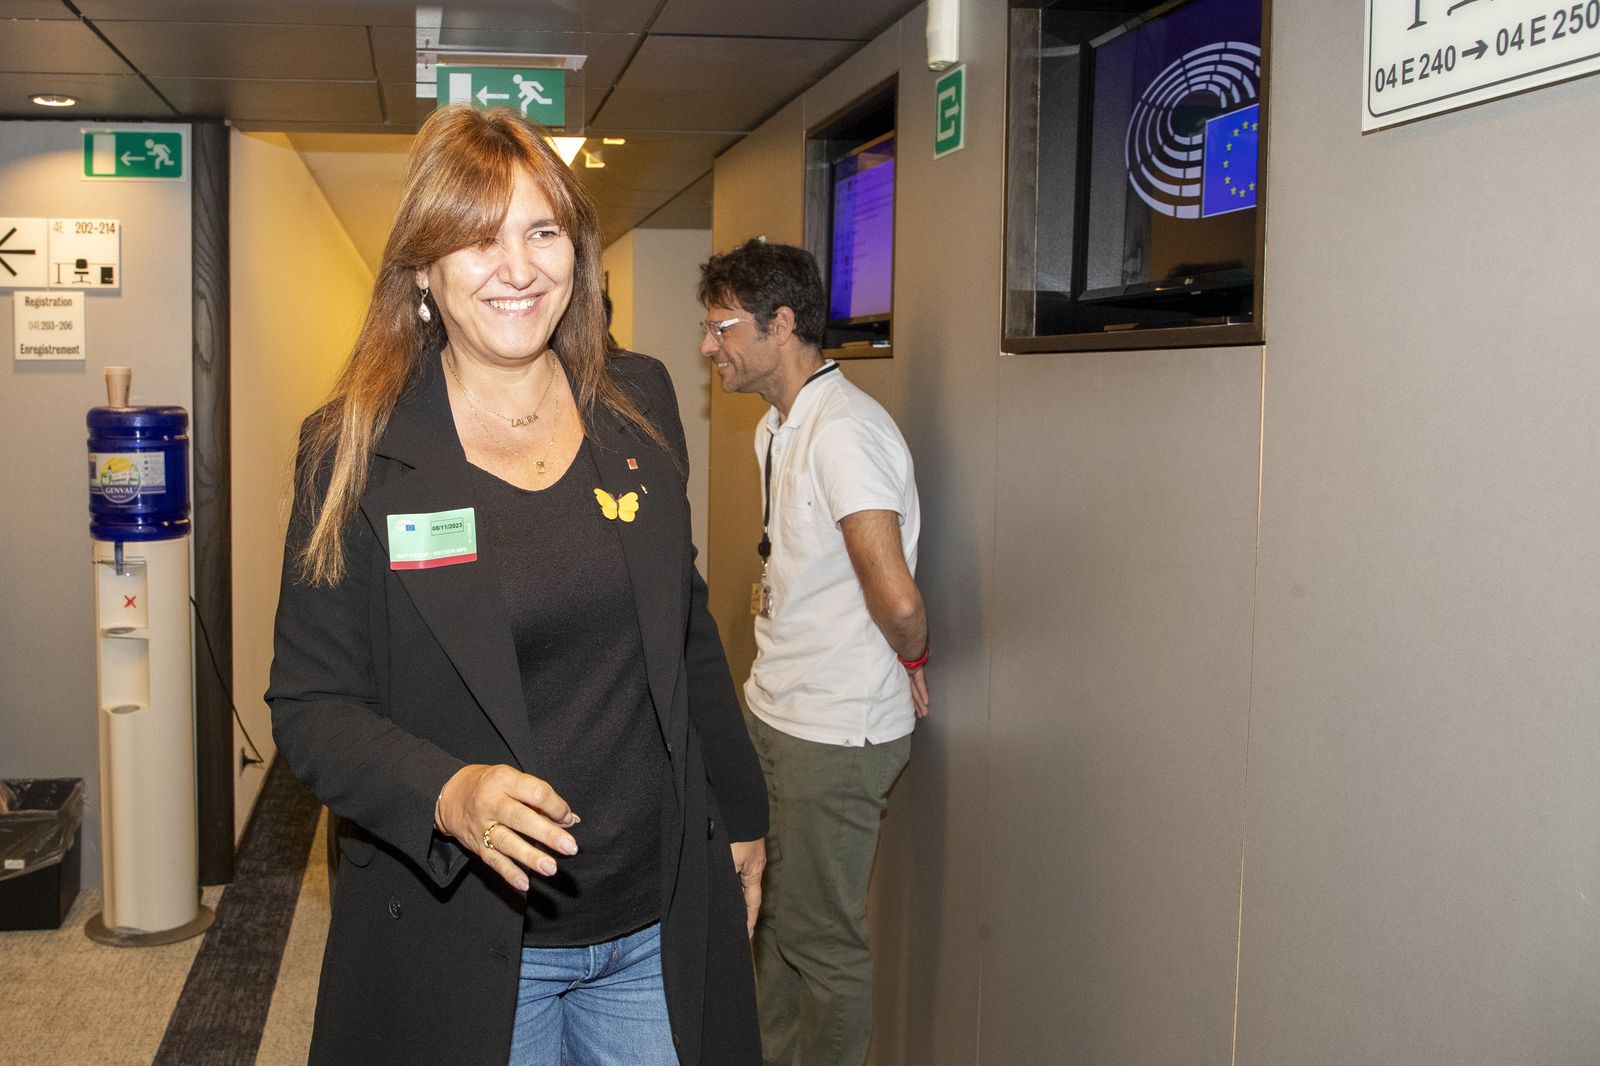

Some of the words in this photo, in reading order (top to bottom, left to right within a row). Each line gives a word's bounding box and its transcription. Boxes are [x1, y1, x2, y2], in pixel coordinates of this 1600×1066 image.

[75, 222, 115, 234] 202-214
[25, 296, 72, 308] Registration
[20, 344, 80, 356] Enregistrement
